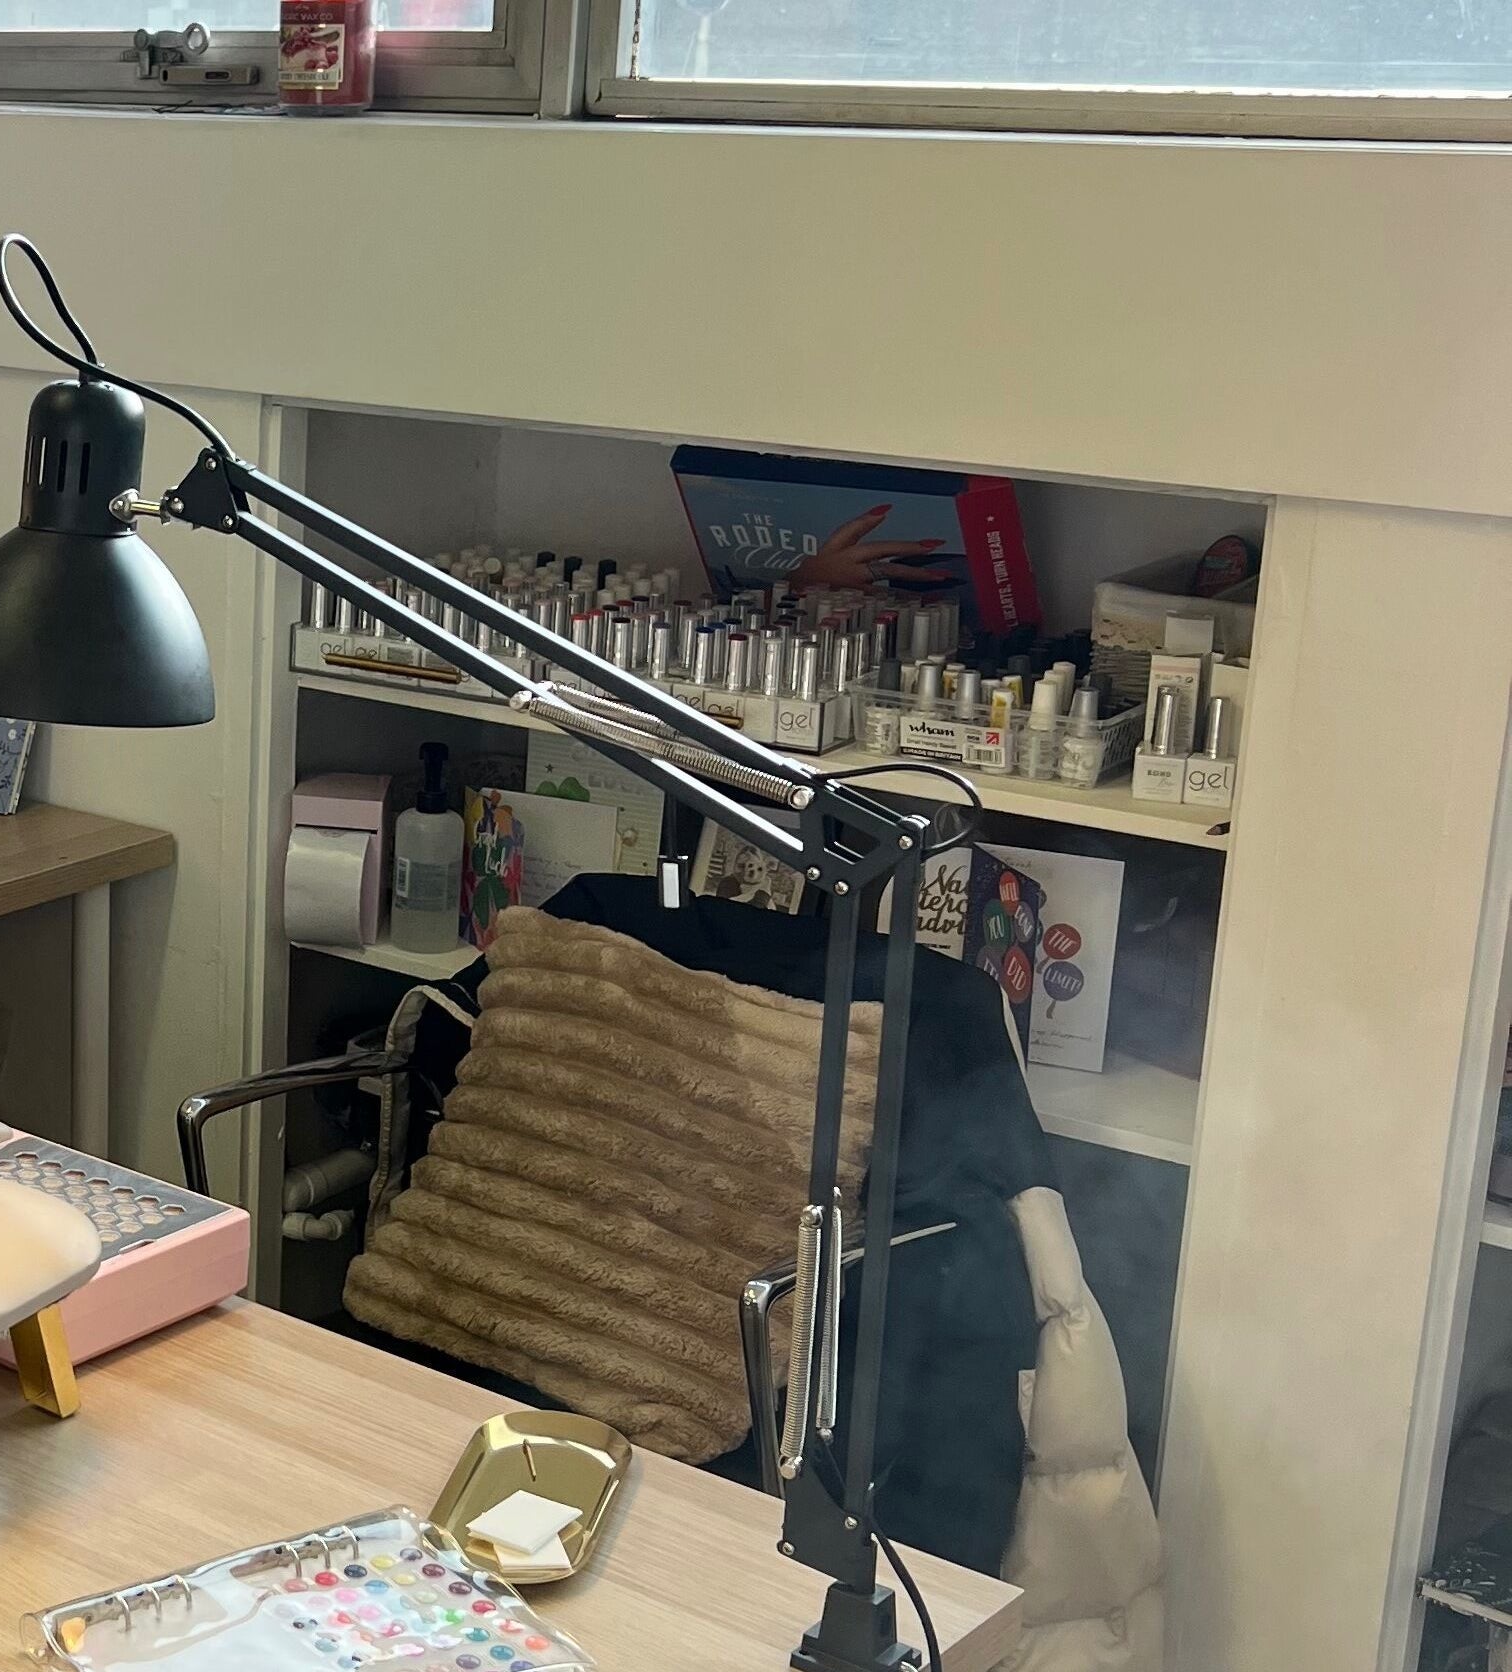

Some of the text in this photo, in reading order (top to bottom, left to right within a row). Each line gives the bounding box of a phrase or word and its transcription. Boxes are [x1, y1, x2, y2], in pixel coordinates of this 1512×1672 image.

[743, 513, 774, 526] THE
[709, 524, 817, 556] RODEO
[780, 707, 816, 731] gel
[909, 721, 955, 736] wham
[1189, 766, 1231, 791] gel
[1047, 929, 1077, 955] THE
[1007, 955, 1027, 991] DID
